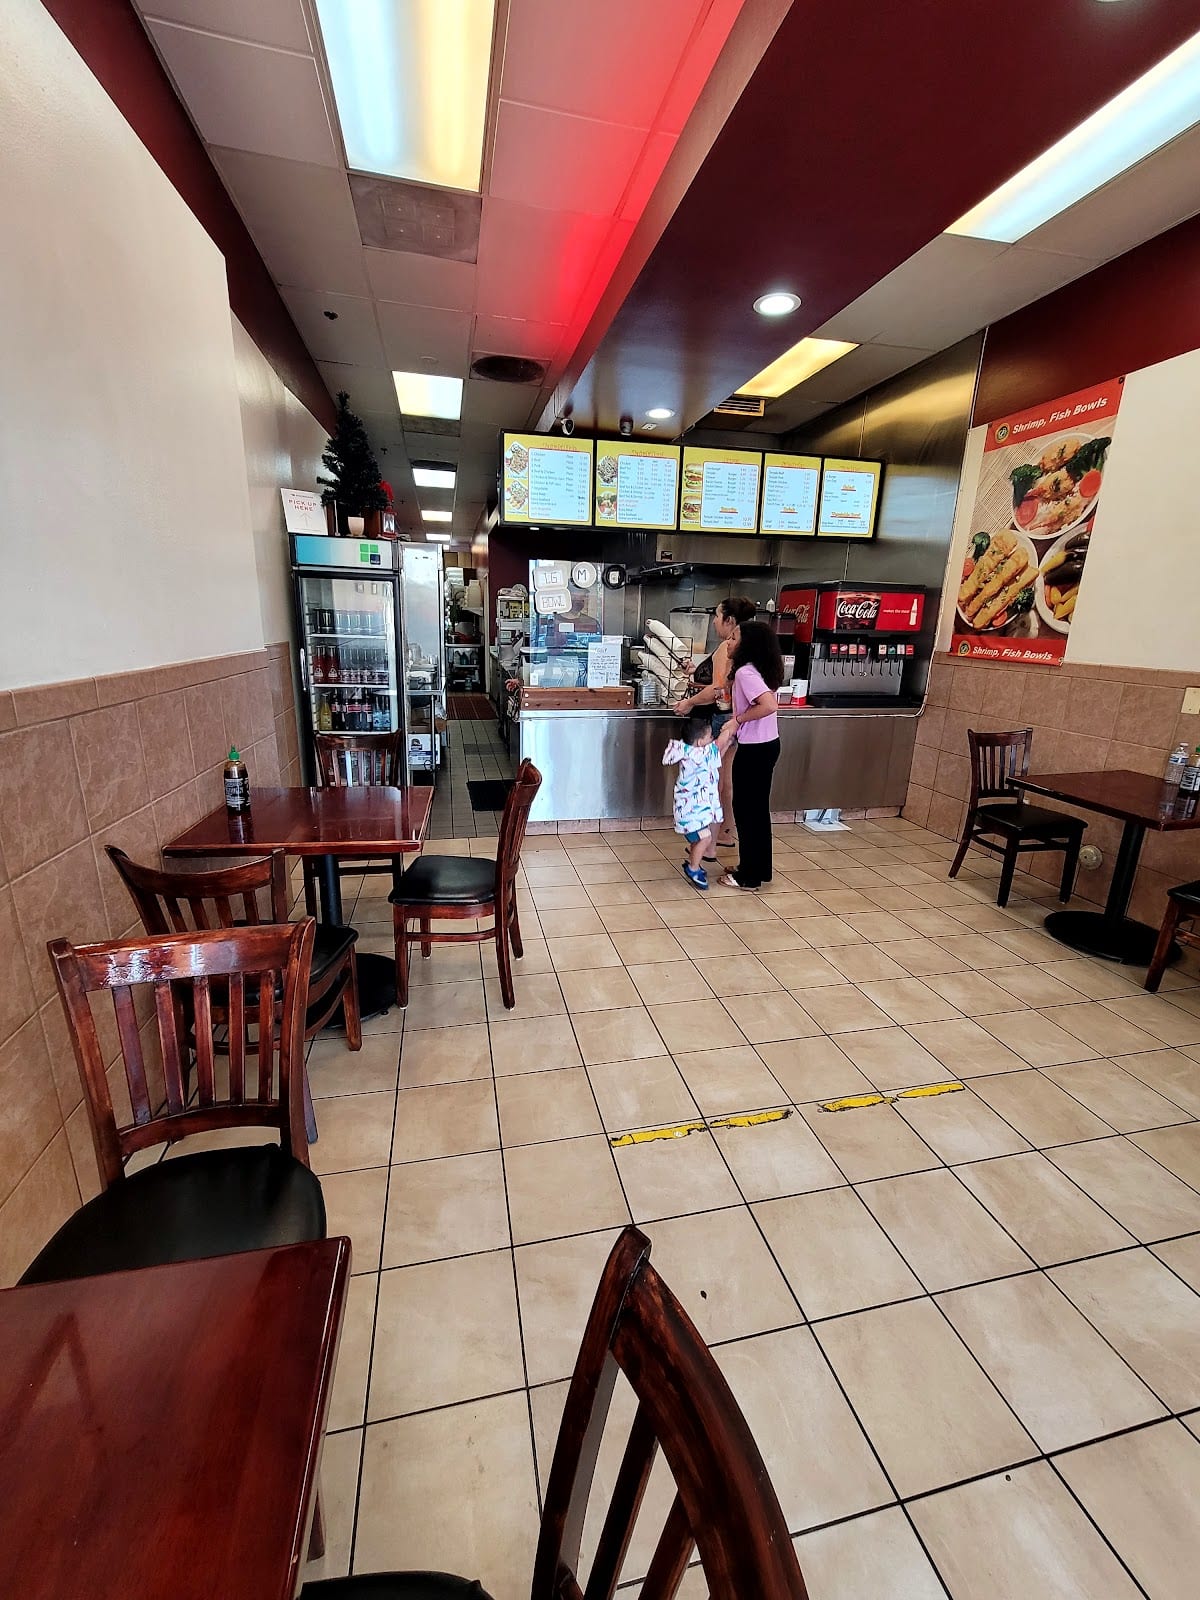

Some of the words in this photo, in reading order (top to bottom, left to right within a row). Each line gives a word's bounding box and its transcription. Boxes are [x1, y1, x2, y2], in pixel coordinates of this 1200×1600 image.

[1012, 418, 1046, 434] Shrimp,
[1049, 408, 1072, 423] Fish
[1073, 397, 1108, 416] Bowls
[577, 569, 587, 581] M
[837, 600, 879, 619] Coca-Cola
[972, 646, 1000, 657] Shrimp,
[1001, 648, 1022, 658] Fish
[1023, 649, 1053, 660] Bowls
